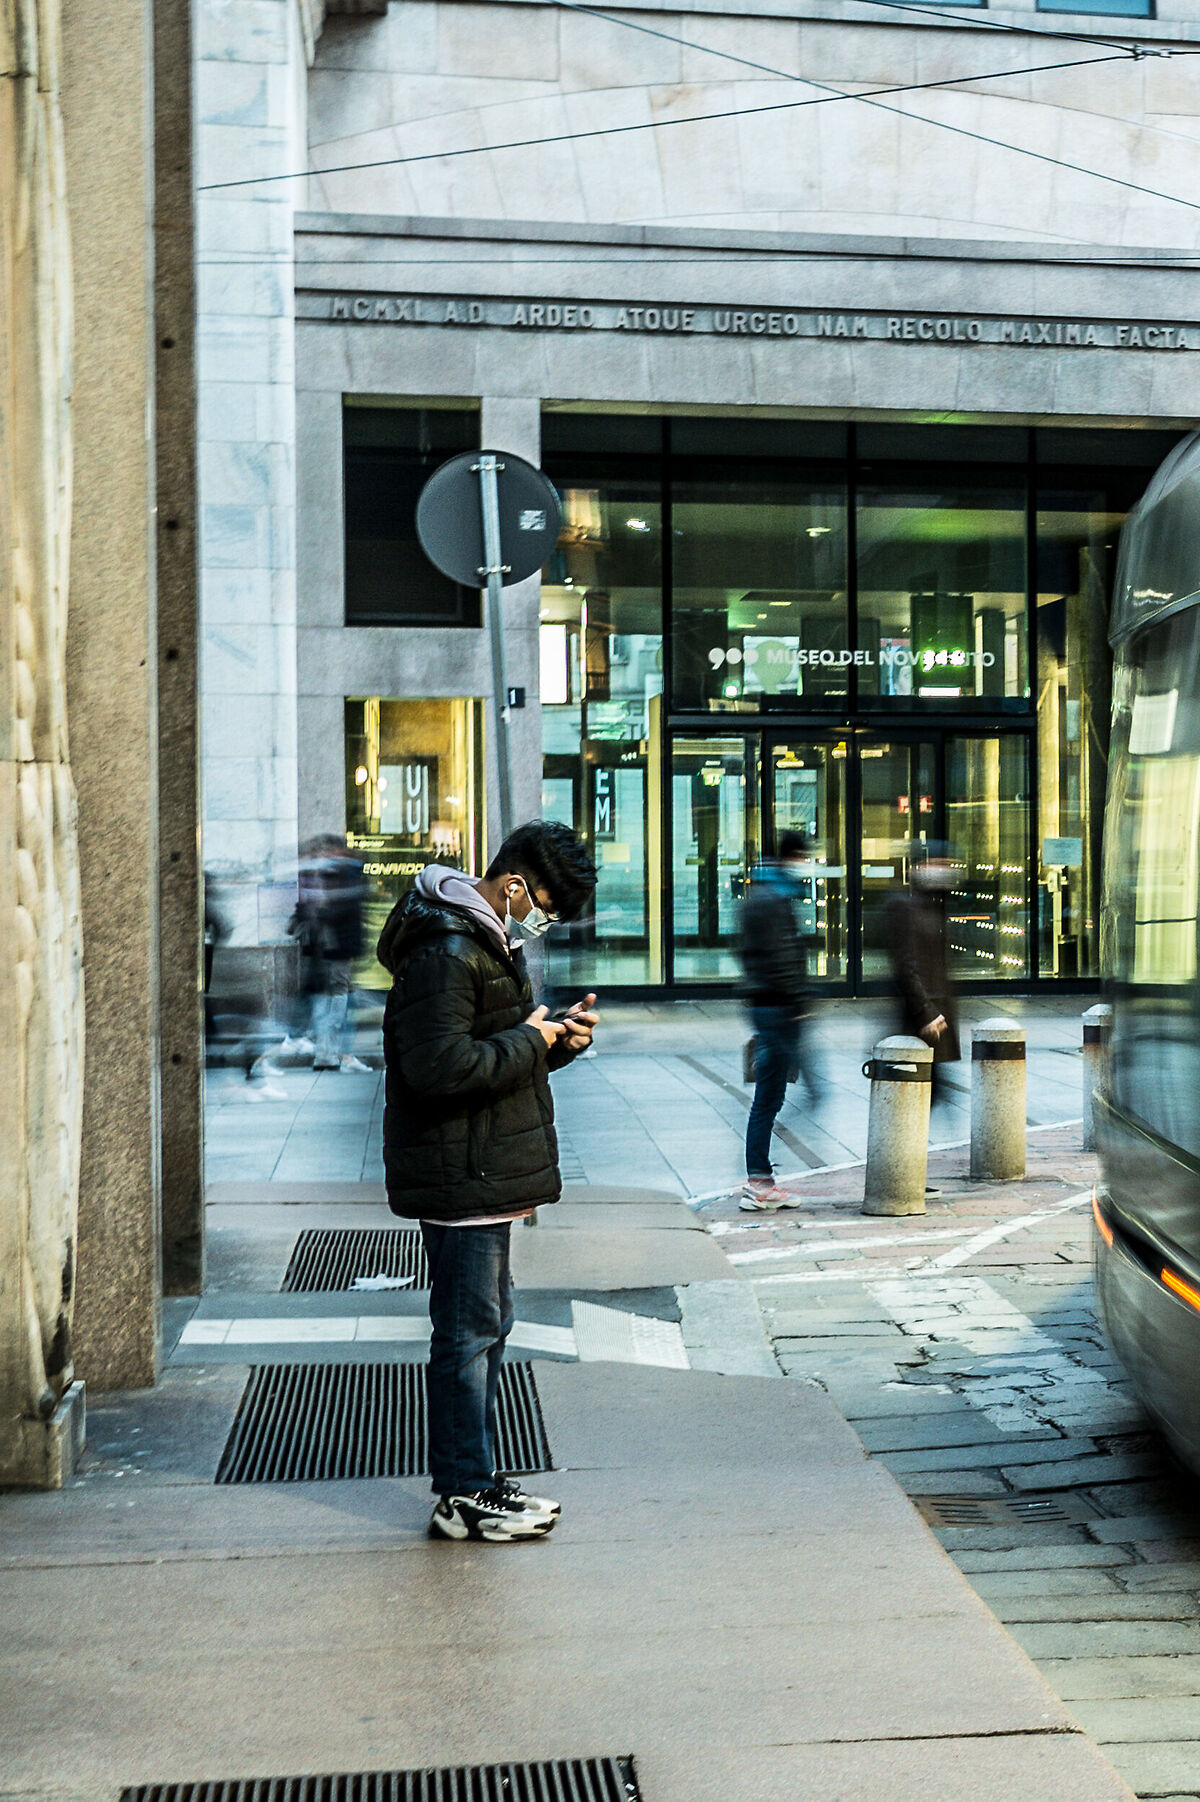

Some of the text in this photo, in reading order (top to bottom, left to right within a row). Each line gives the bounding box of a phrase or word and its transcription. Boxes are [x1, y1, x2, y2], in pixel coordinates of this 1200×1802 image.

[512, 303, 595, 328] ARDEO
[713, 310, 800, 335] URGEO
[818, 314, 868, 338] NAM
[887, 317, 982, 342] RECOLO
[1001, 320, 1097, 345] MAXIMA
[1115, 325, 1187, 349] FACTA
[767, 649, 835, 666] MUSEO
[839, 650, 875, 666] DEL
